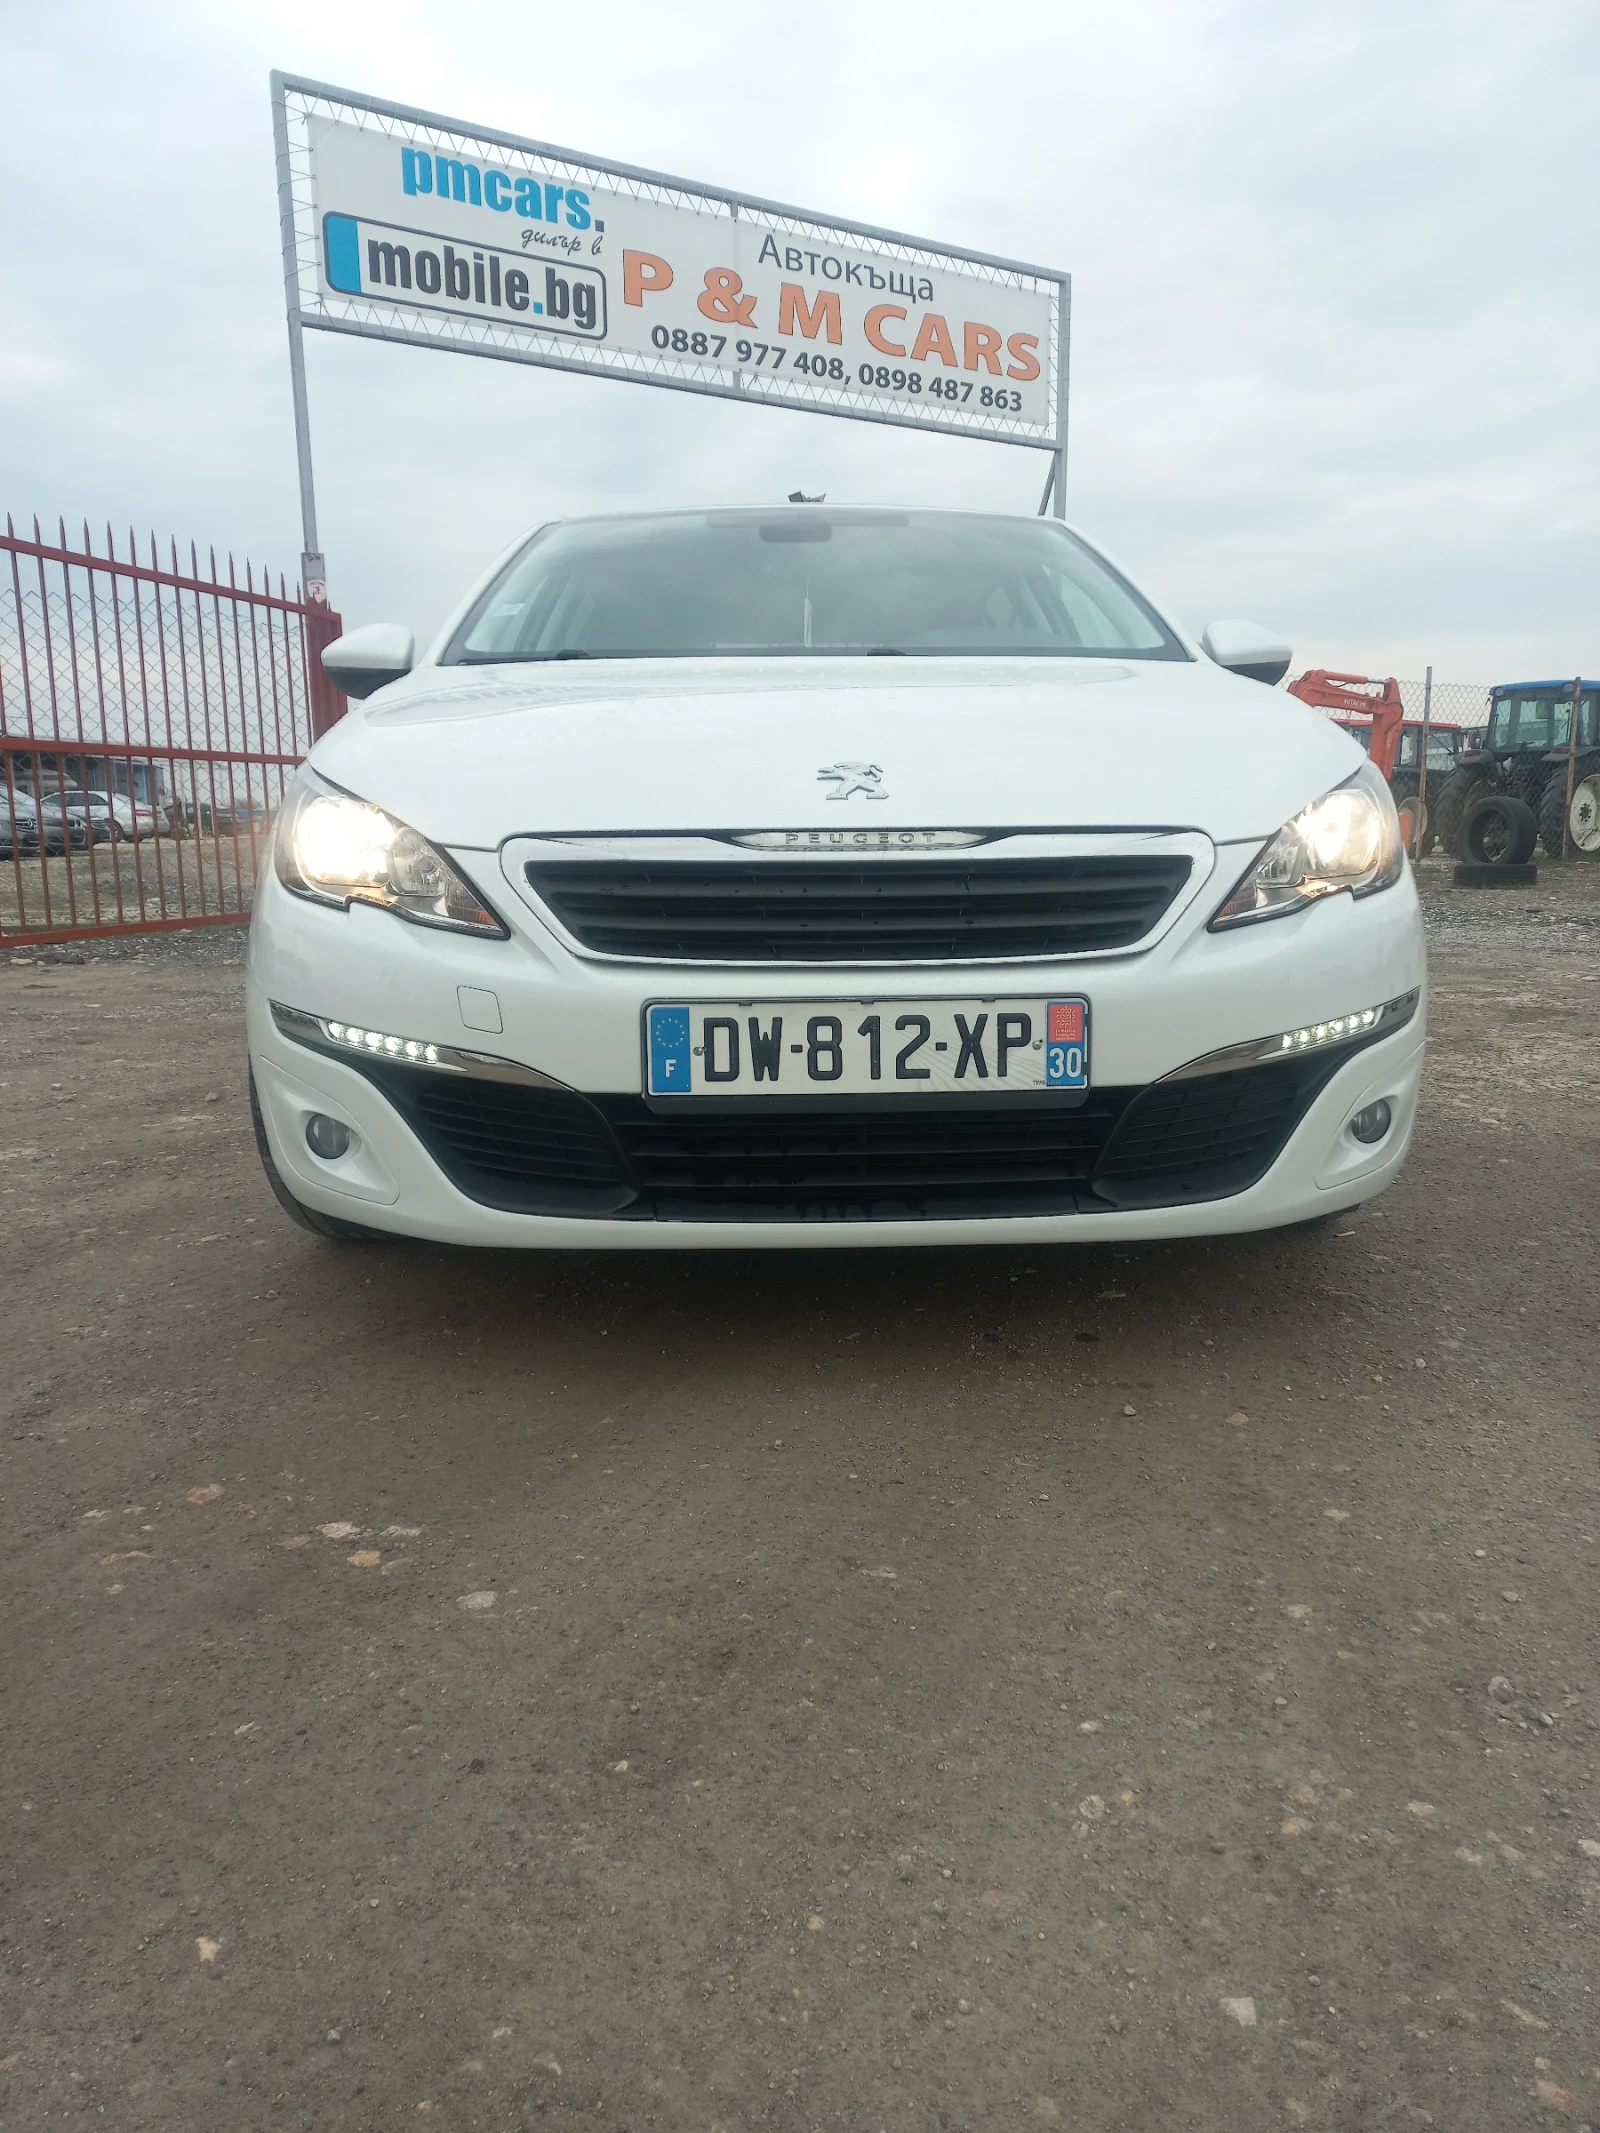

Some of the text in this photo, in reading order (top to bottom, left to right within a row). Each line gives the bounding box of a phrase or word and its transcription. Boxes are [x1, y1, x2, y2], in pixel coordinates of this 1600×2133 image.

[401, 146, 604, 232] pmcars.
[521, 229, 603, 256] дилър в
[757, 233, 934, 304] Автокъща
[367, 238, 597, 330] mobile.bg
[622, 248, 1041, 382] P & M CARS
[651, 324, 1023, 412] 0887 977 408, 0898 487 863
[785, 832, 936, 845] PEUGEOT
[665, 1059, 677, 1078] F
[703, 1012, 1032, 1082] DW-812-XP
[1049, 1047, 1082, 1078] 30
